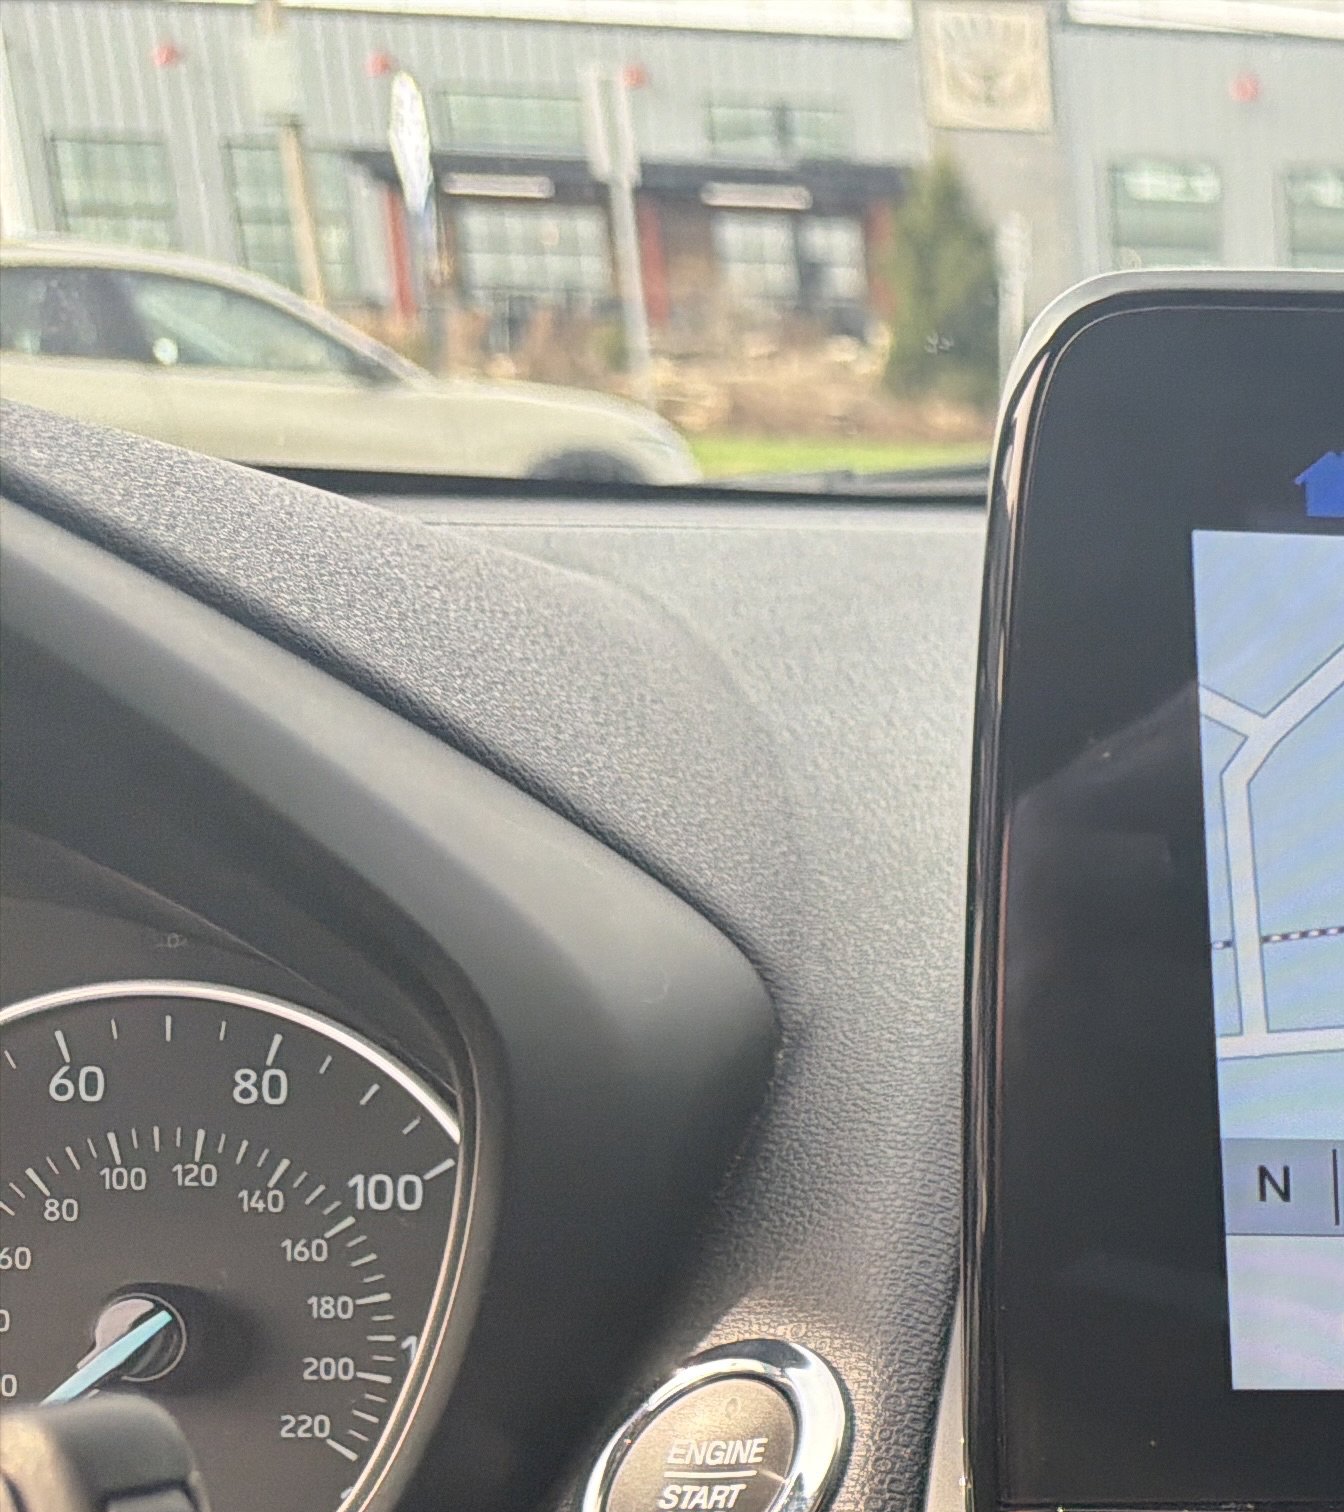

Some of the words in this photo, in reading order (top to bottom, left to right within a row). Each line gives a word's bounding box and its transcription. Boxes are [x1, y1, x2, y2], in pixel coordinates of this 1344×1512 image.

[48, 1065, 106, 1103] 60
[231, 1068, 289, 1106] 80
[99, 1166, 148, 1192] 100
[172, 1163, 219, 1188] 120
[1258, 1165, 1292, 1204] N
[237, 1188, 286, 1214] 140
[347, 1173, 424, 1212] 100
[43, 1198, 79, 1223] 80
[281, 1237, 329, 1263] 160
[307, 1294, 355, 1320] 180
[302, 1356, 355, 1382] 200
[280, 1414, 331, 1439] 220
[666, 1437, 769, 1466] ENGINE
[657, 1483, 748, 1510] START
